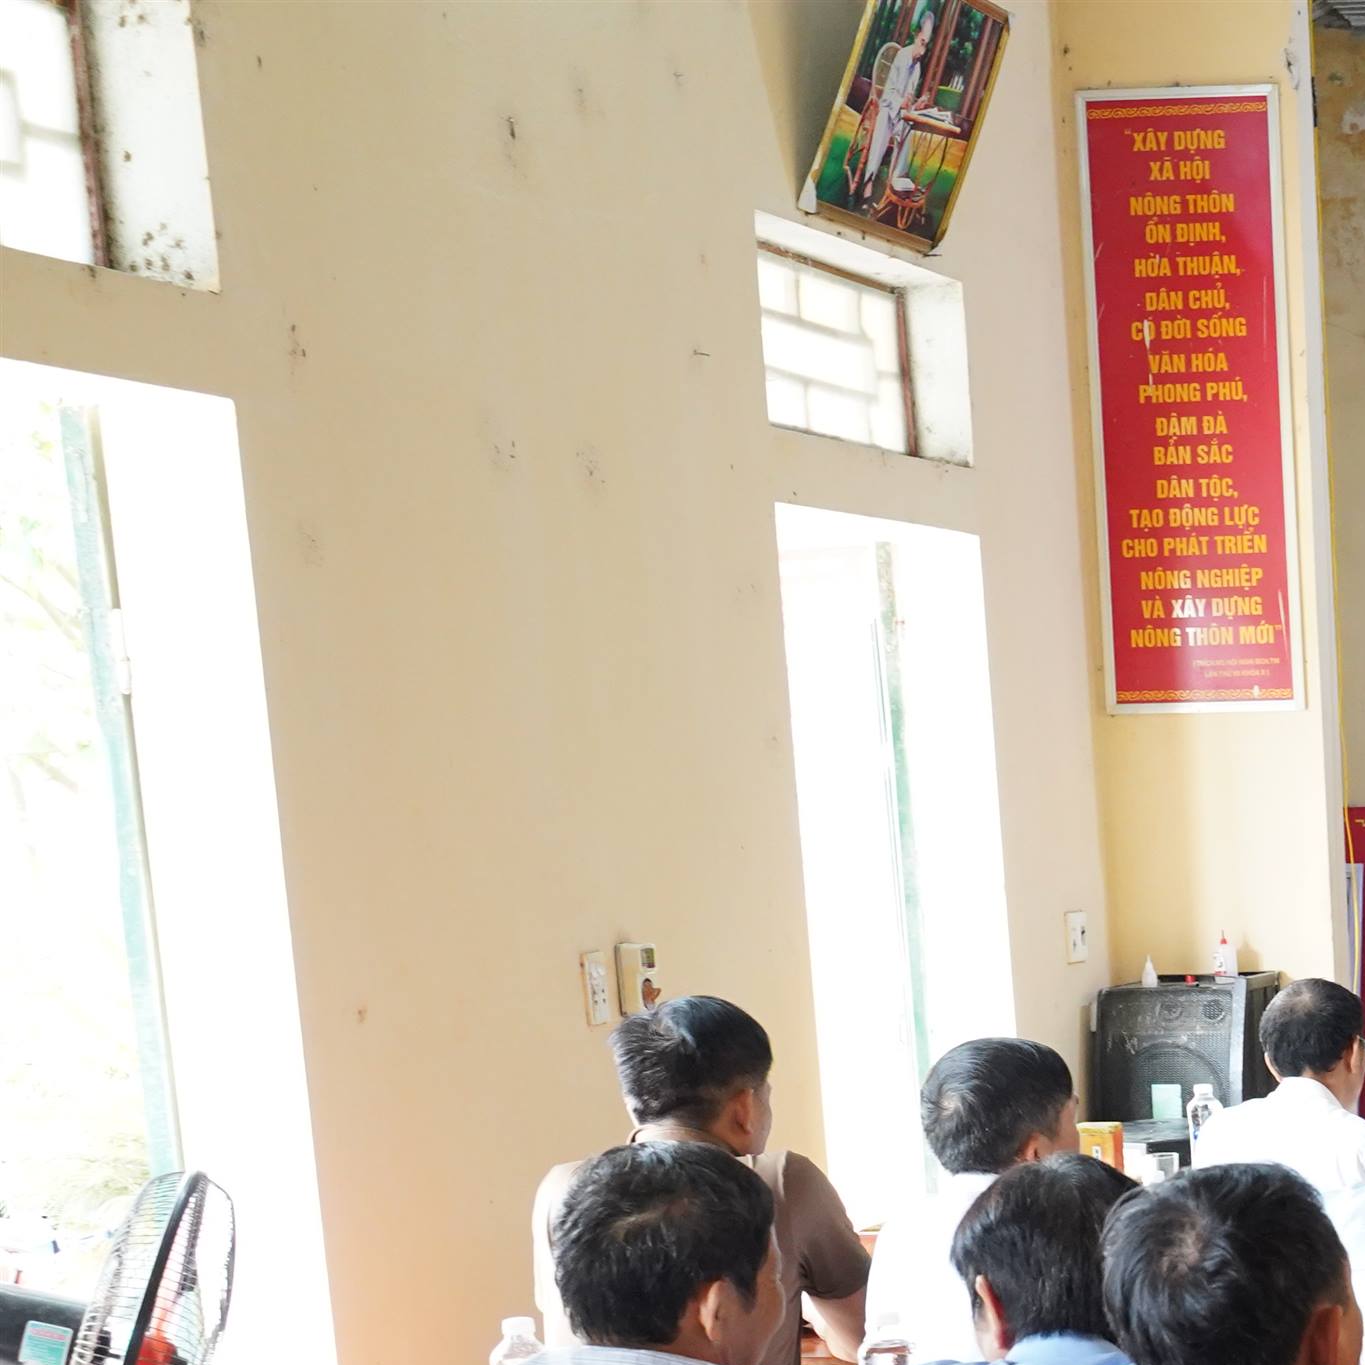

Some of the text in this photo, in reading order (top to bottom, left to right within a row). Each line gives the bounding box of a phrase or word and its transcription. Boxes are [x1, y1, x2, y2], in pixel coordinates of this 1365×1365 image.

[1173, 129, 1226, 154] DỰNG
[1149, 155, 1210, 183] XÃ HỘI
[1130, 189, 1235, 216] NÔNG THÔN
[1176, 221, 1226, 246] ĐỊNH,
[1176, 250, 1241, 279] THUẬN,
[1145, 281, 1231, 311] DÂN CHỦ,
[1160, 315, 1191, 340] ĐỜI
[1196, 311, 1248, 337] SỐNG
[1148, 347, 1229, 374] VĂN HÓA
[1139, 376, 1248, 404] PHONG PHÚ,
[1155, 410, 1228, 440] ĐẬM ĐÀ
[1153, 437, 1233, 465] BẢN SẮC
[1156, 474, 1239, 501] DÂN TỘC,
[1129, 503, 1260, 532] TẠO ĐỘNG LỰC
[1122, 526, 1268, 559] CHO PHÁT TRIỂN
[1140, 563, 1263, 591] NÔNG NGHIỆP
[1141, 594, 1263, 621] VÀ XÂY DỰNG
[1130, 624, 1182, 648] NÔNG
[1185, 623, 1234, 647] THÔN
